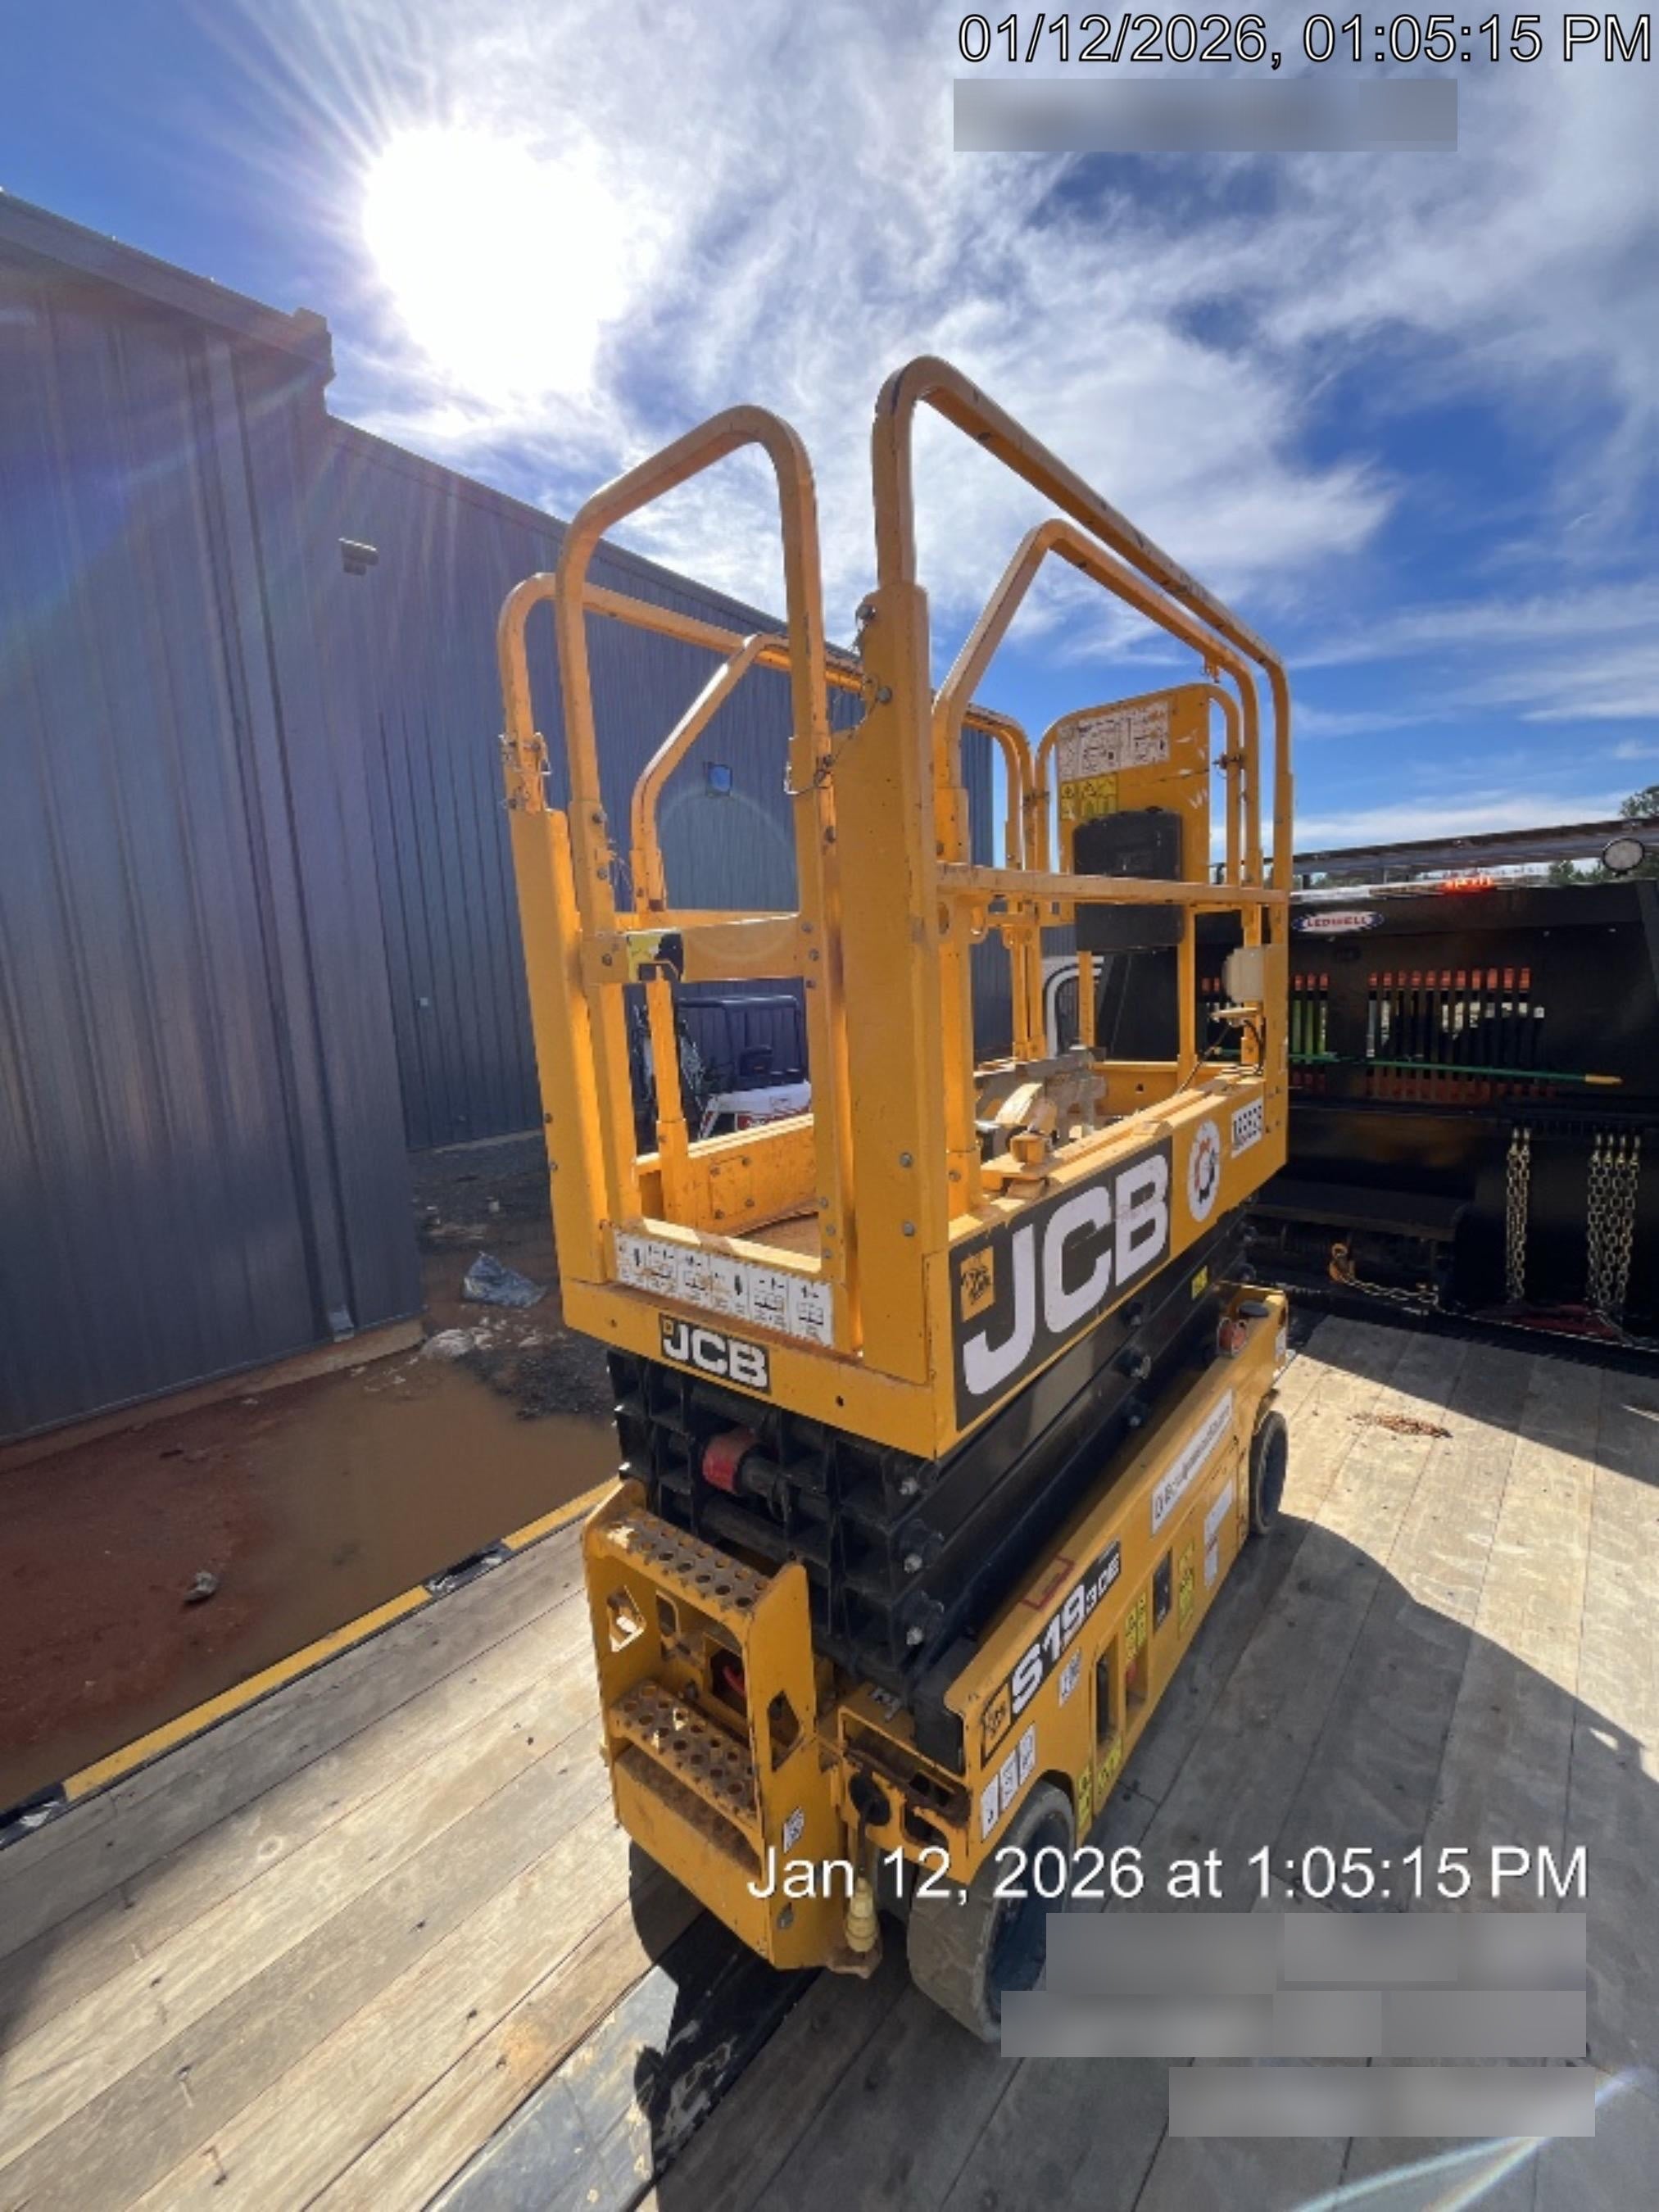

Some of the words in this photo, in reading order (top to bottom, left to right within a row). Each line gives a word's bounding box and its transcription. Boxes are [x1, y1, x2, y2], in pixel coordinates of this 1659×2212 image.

[1306, 915, 1367, 928] LEDWELL
[963, 1154, 1169, 1396] JCB
[663, 1323, 768, 1388] JCB
